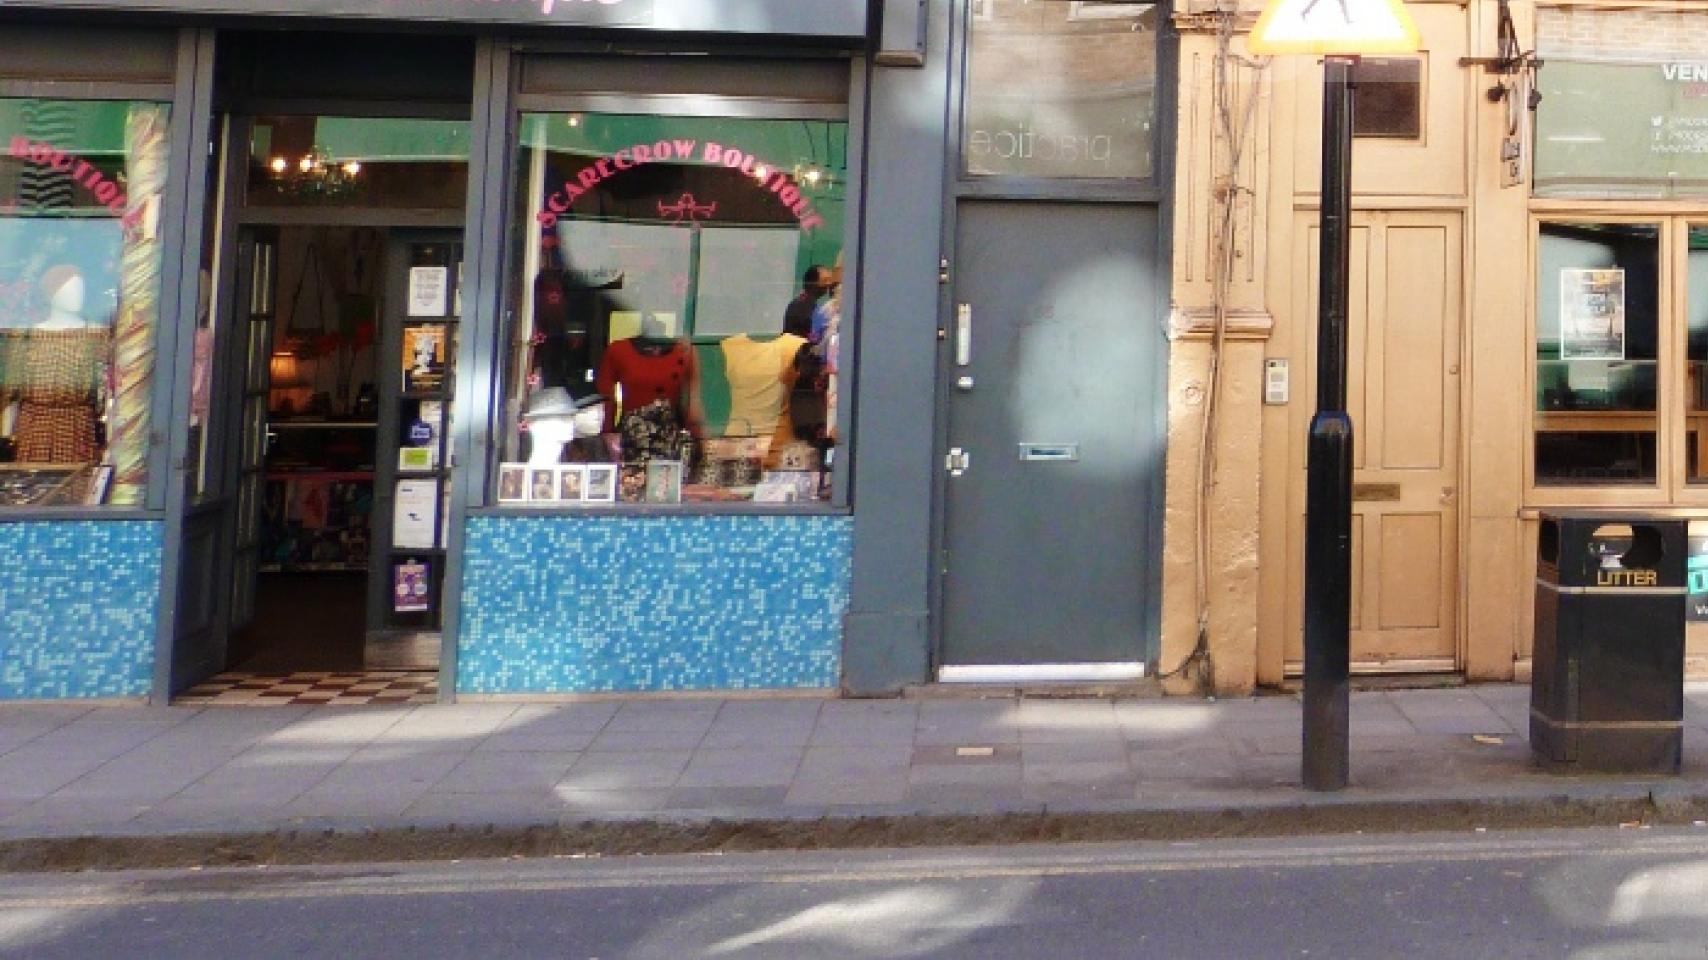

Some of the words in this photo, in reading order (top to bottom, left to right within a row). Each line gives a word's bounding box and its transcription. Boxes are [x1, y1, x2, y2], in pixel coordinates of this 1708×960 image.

[537, 140, 696, 228] SCARECROW
[703, 142, 824, 235] BOUTIQUE
[1597, 569, 1656, 585] LITTER
